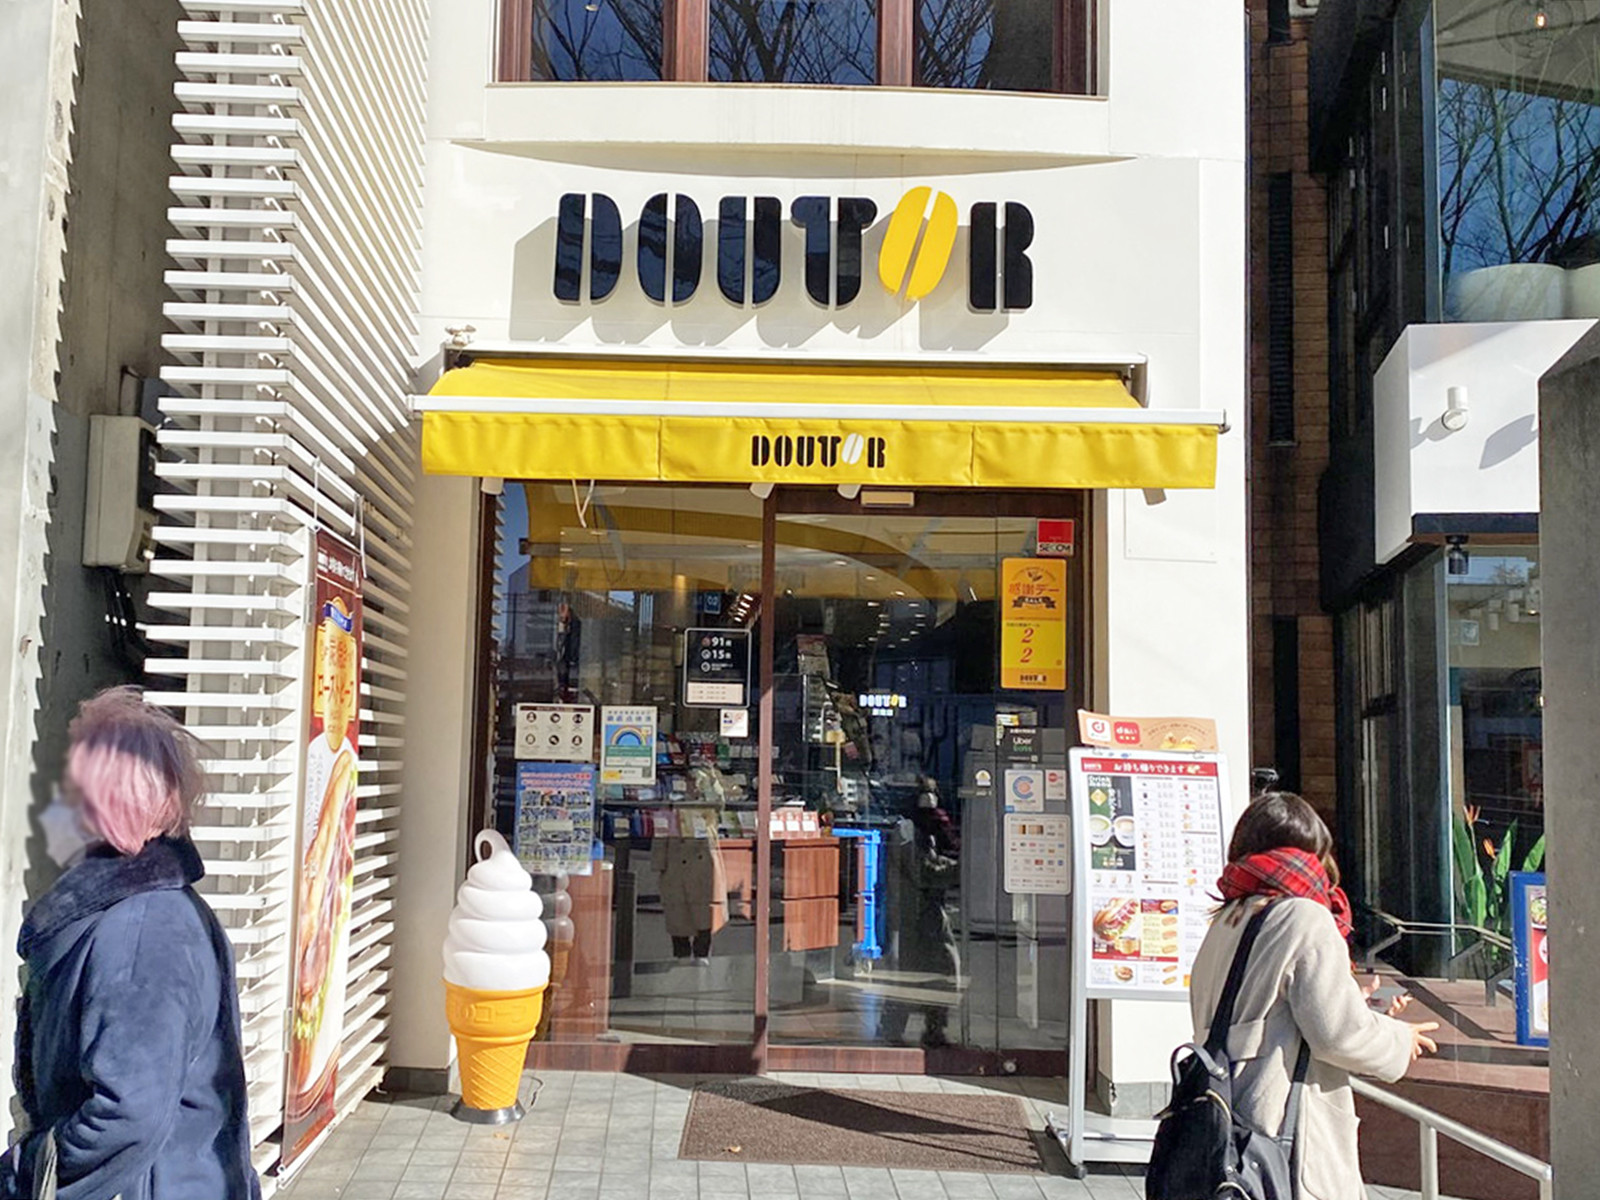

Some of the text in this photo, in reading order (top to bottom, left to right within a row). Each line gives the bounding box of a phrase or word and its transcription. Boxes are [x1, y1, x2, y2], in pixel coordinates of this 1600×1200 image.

[553, 186, 1035, 309] DOUTOR
[751, 433, 886, 469] DOUTOR
[1039, 543, 1072, 553] SECOM
[1021, 627, 1034, 643] 2
[1020, 647, 1033, 663] 2
[859, 694, 907, 708] DOUTOR
